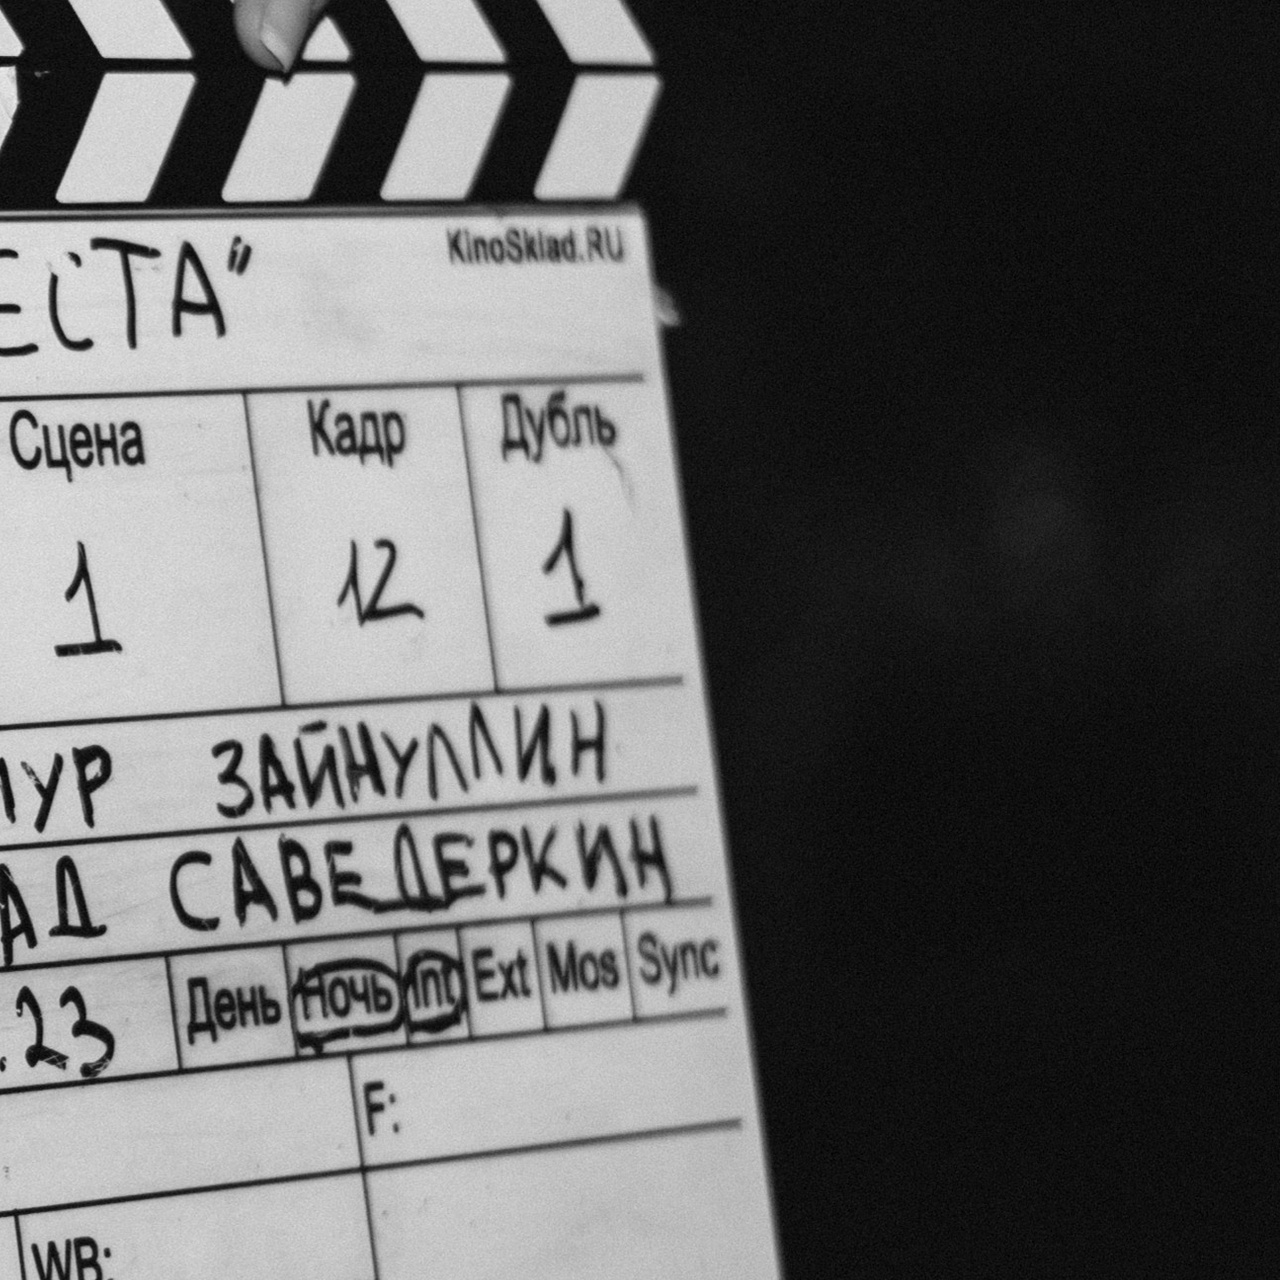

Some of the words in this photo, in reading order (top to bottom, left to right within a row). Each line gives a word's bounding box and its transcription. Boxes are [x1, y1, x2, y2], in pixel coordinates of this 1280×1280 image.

[446, 225, 624, 265] KinoSklad.RU
[9, 409, 146, 483] Сцена
[307, 399, 406, 468] Кадр
[500, 390, 617, 463] Дубль
[54, 541, 122, 657] 1
[337, 539, 425, 626] 12
[543, 508, 601, 626] 1
[211, 699, 606, 819] ЗАЙНУЛЛИН
[169, 815, 674, 931] САВЕДЕРКИН
[297, 967, 394, 1021] Ночь
[472, 946, 533, 1005] Ext
[546, 939, 621, 995] Mos
[637, 930, 720, 998] Sync
[186, 977, 283, 1045] День
[363, 1080, 400, 1136] F:
